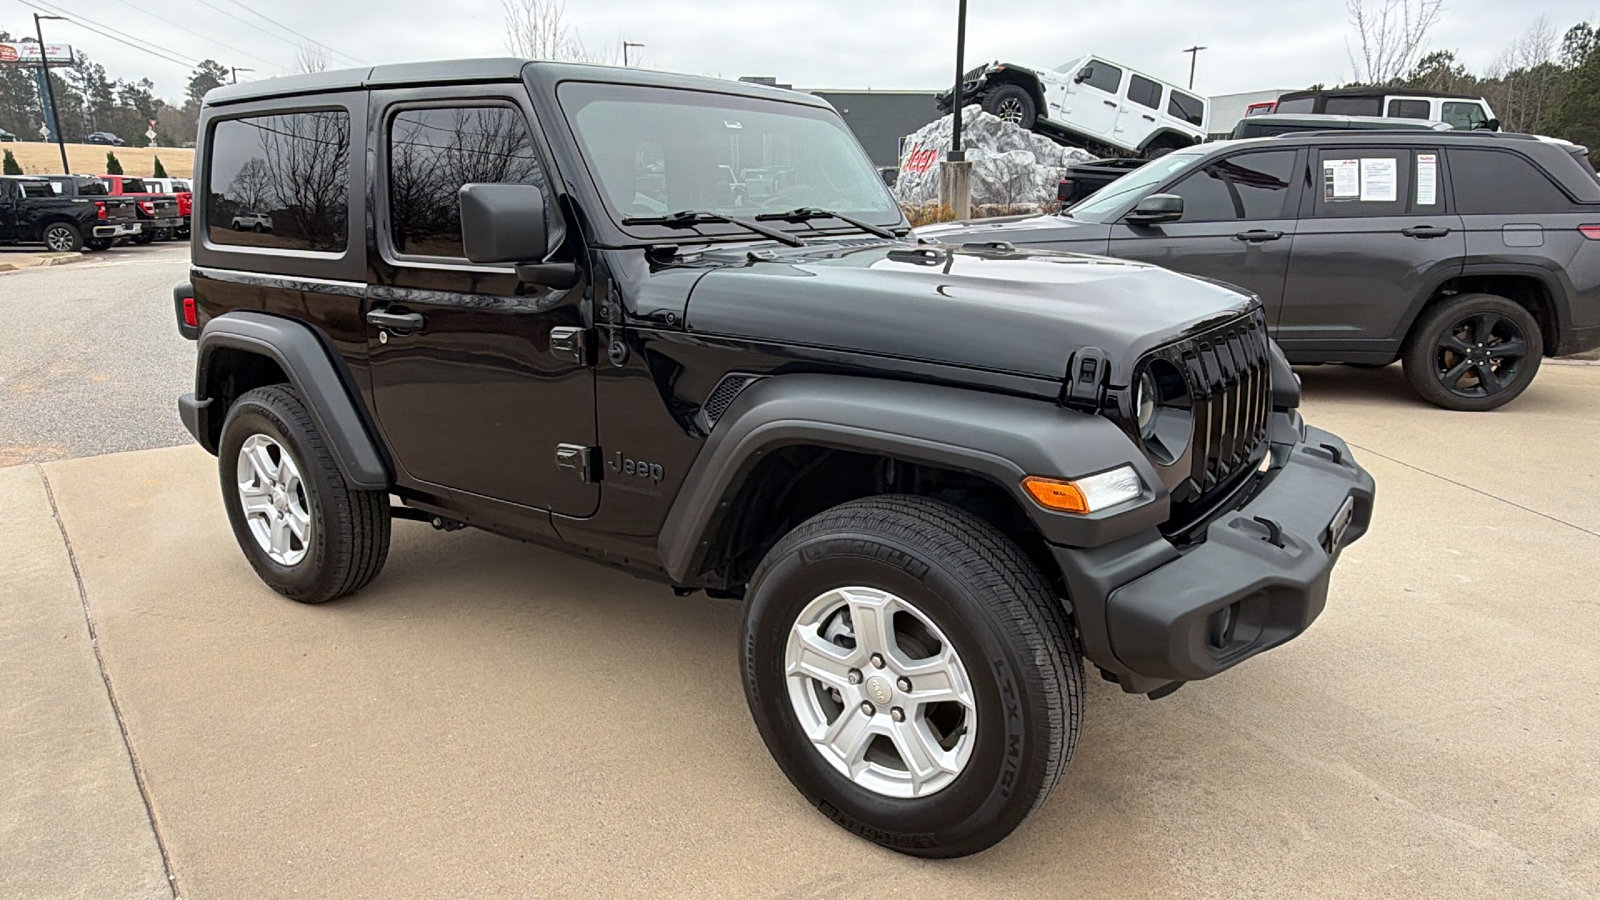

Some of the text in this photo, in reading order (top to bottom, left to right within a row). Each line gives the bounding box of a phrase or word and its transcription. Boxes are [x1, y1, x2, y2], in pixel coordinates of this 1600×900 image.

[902, 141, 938, 178] Jeep
[607, 451, 665, 486] Jeep
[993, 658, 1020, 721] LTX
